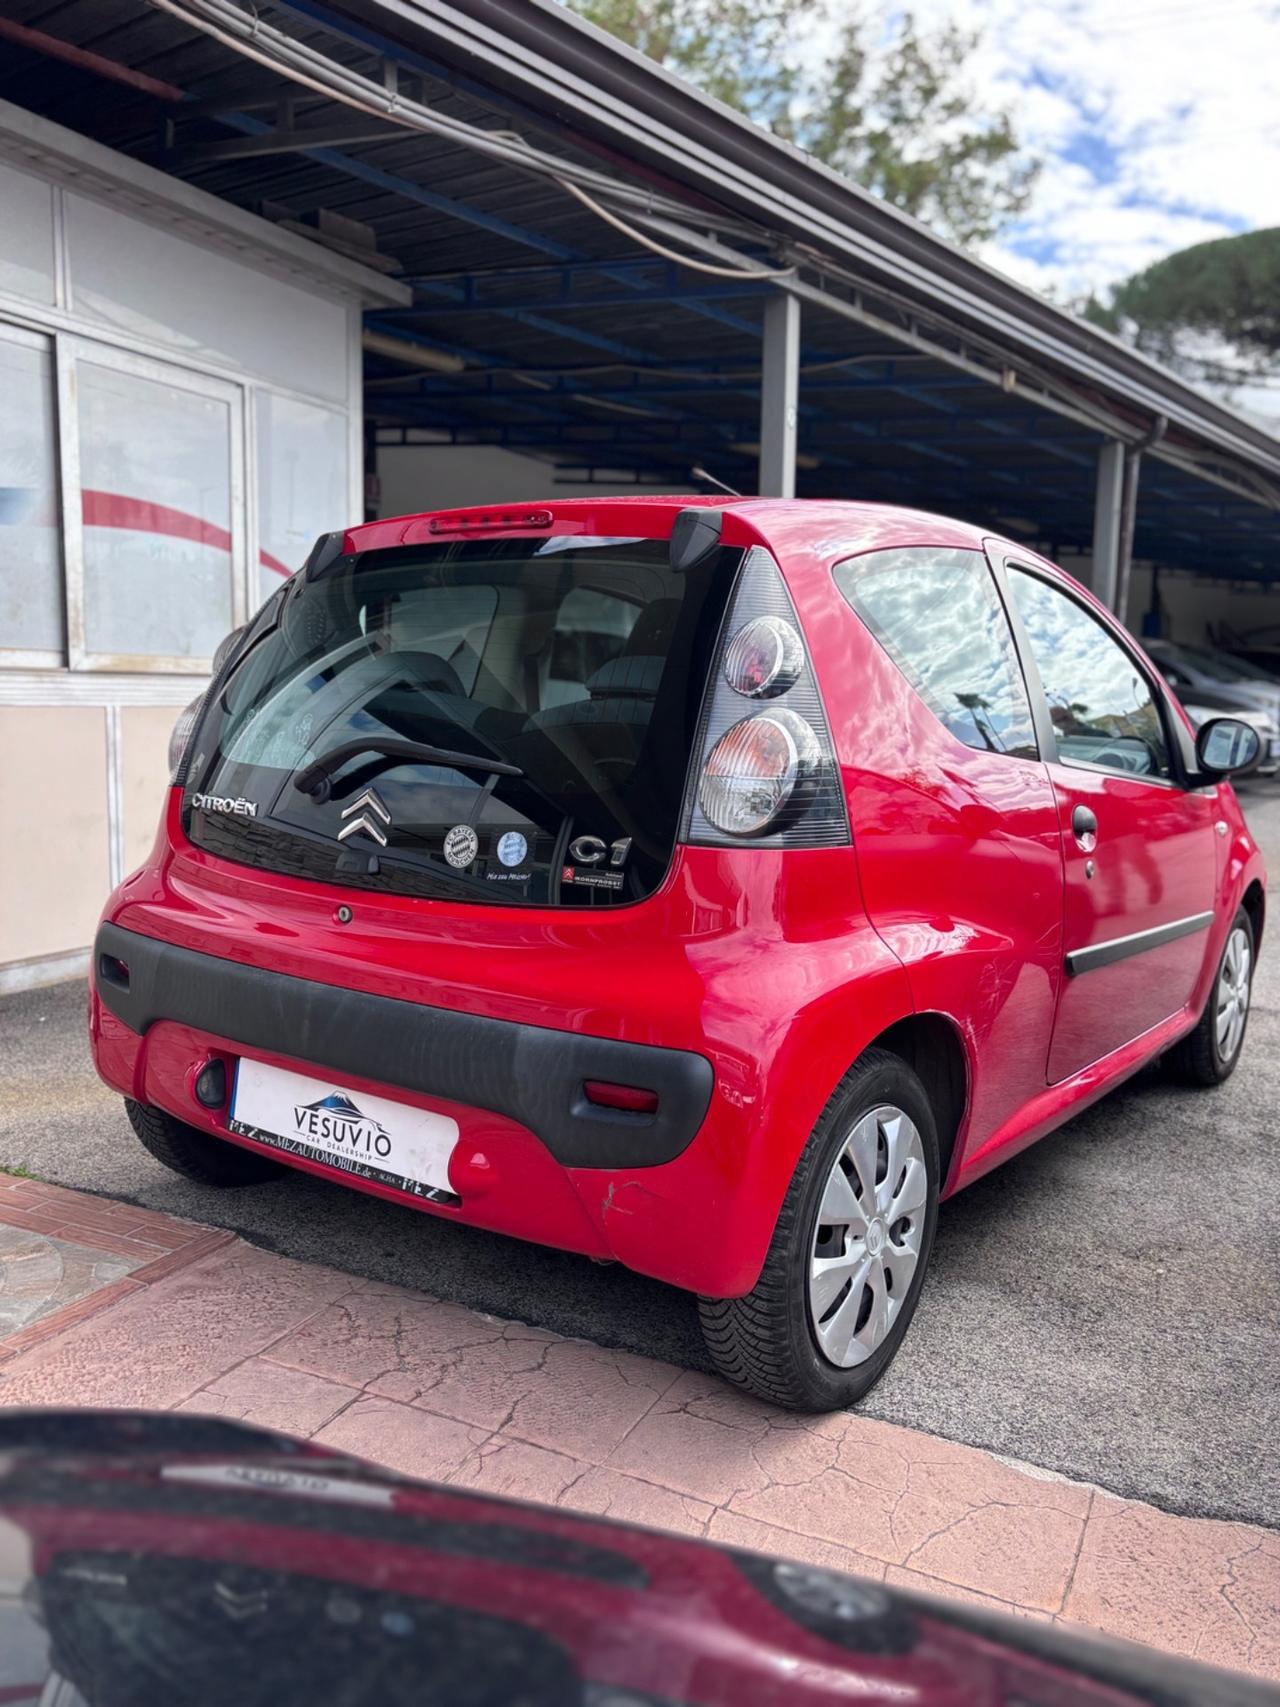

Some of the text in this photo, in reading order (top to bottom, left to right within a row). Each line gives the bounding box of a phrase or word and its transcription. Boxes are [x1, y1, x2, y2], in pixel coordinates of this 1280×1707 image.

[191, 793, 258, 817] CITROËN
[568, 835, 633, 865] C1
[294, 1107, 392, 1157] VESUVIO
[306, 1135, 373, 1162] CAR DEALERSHIP
